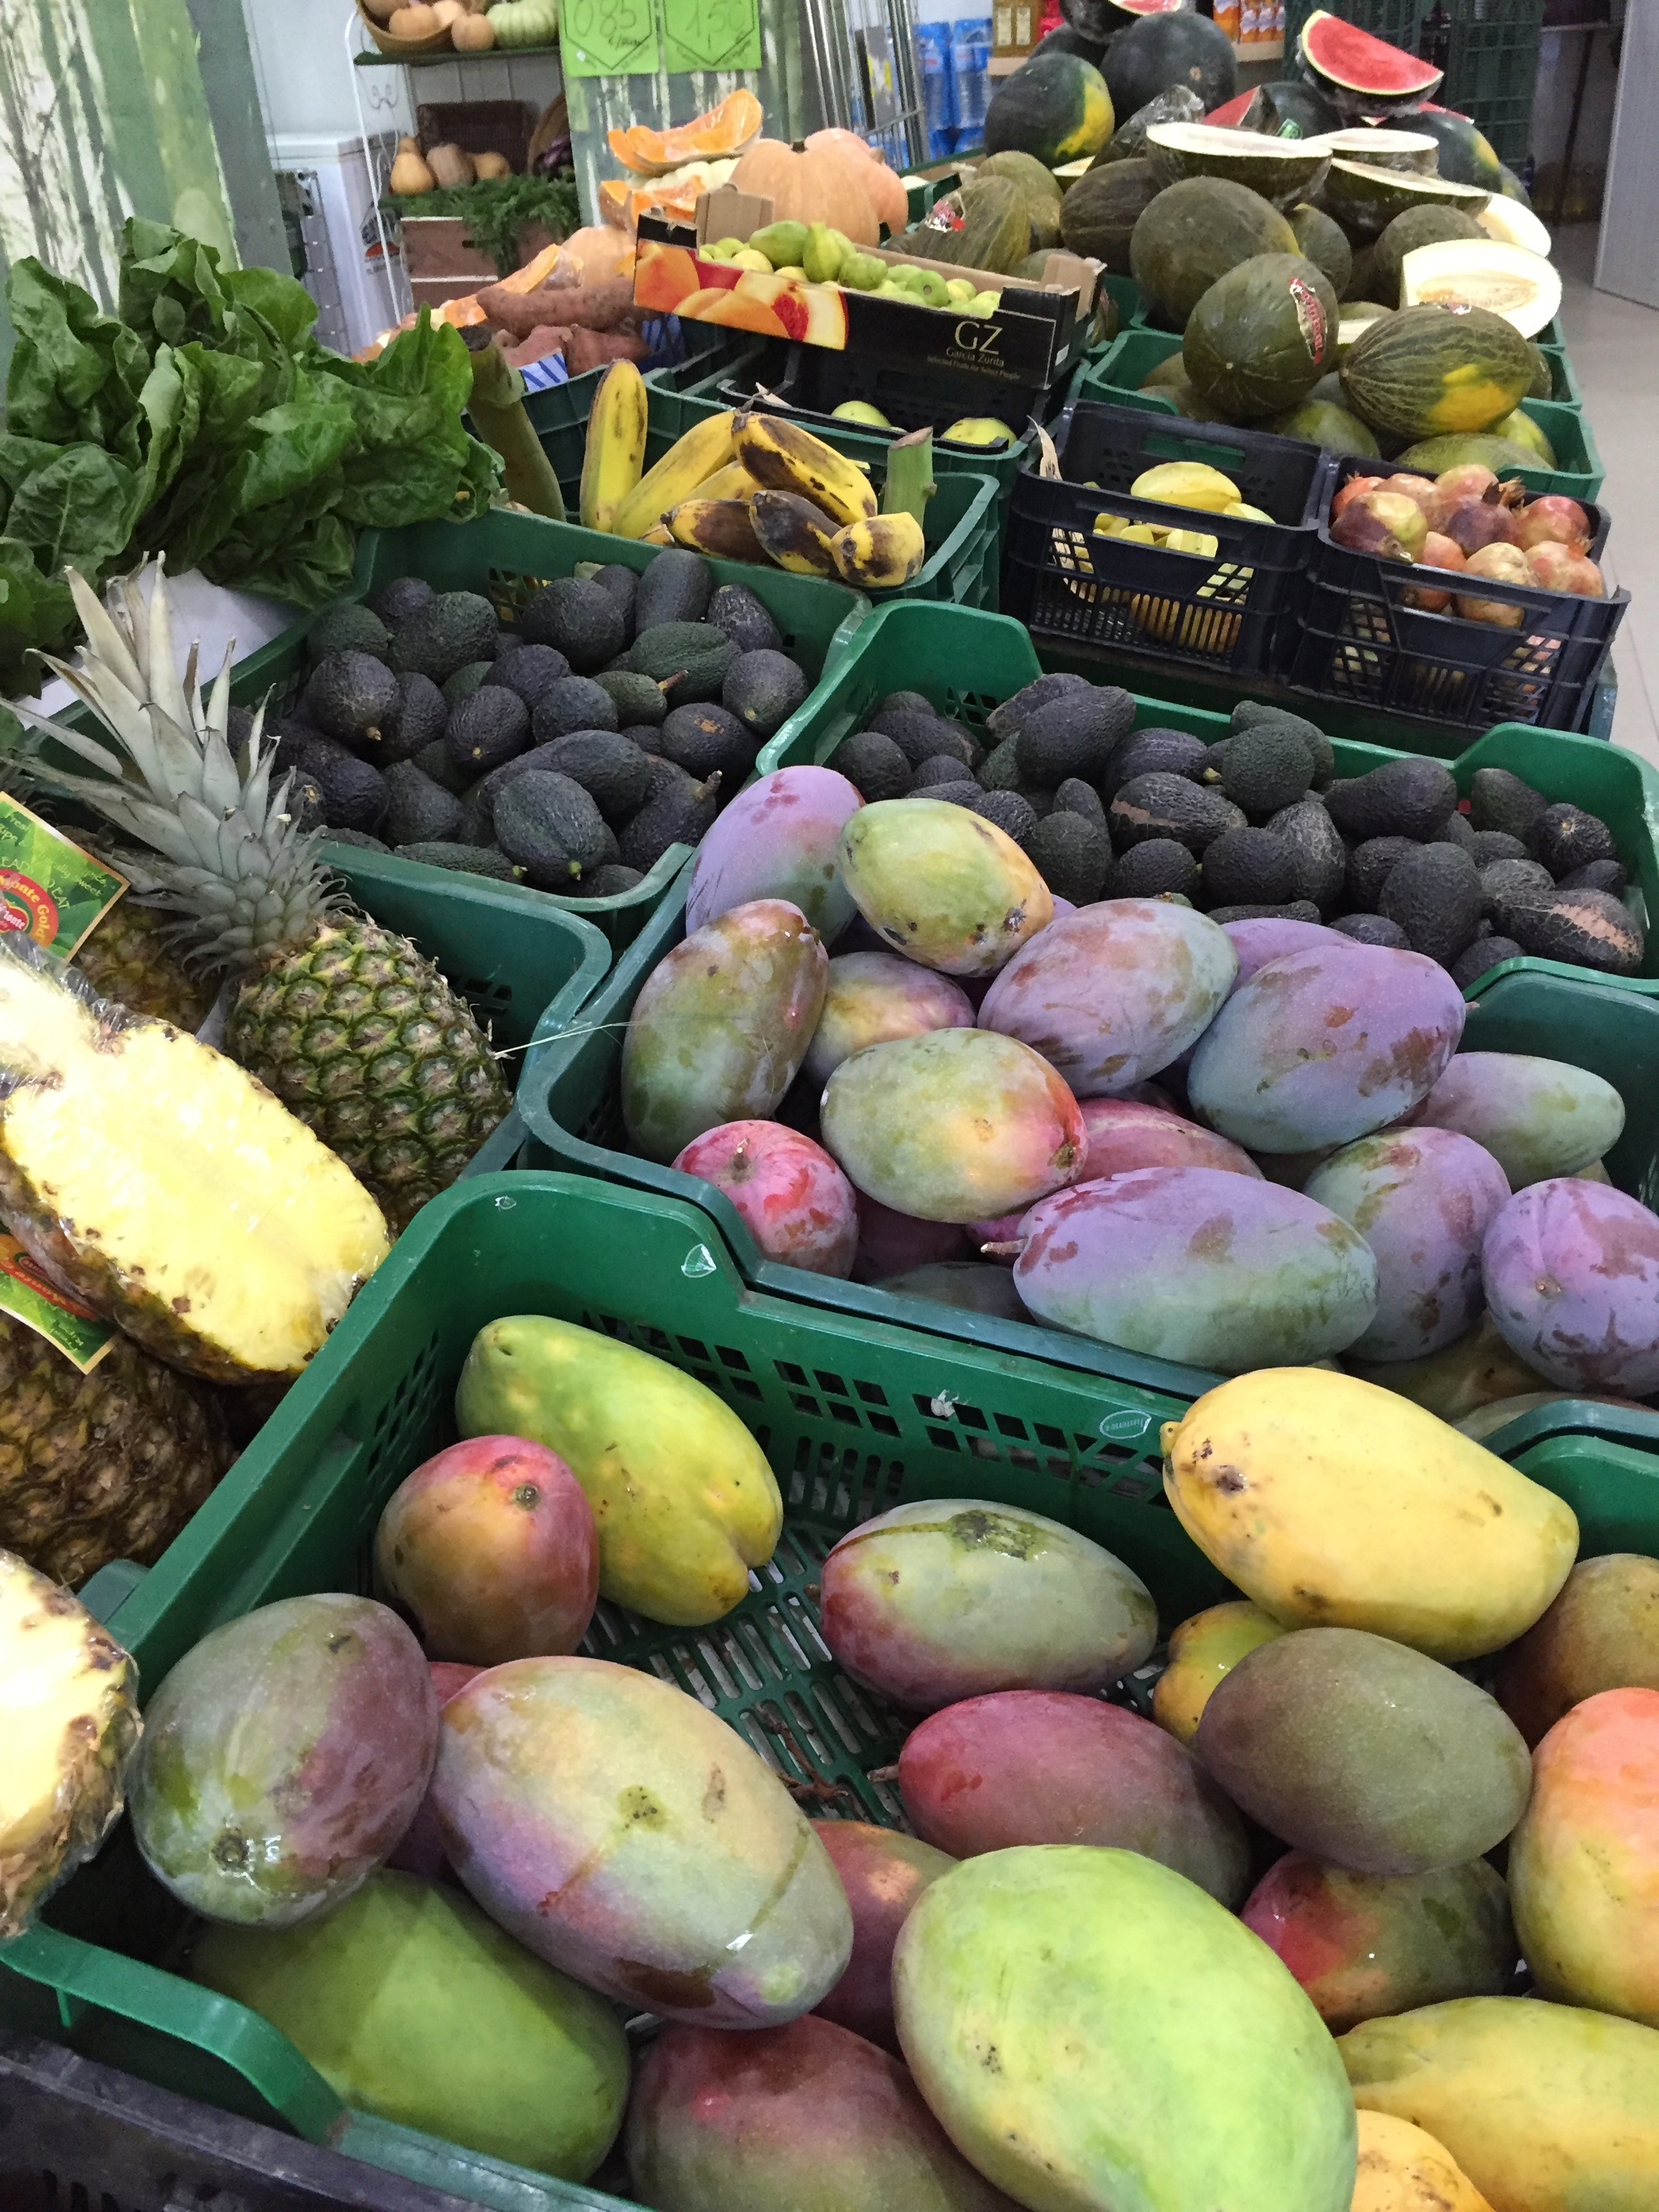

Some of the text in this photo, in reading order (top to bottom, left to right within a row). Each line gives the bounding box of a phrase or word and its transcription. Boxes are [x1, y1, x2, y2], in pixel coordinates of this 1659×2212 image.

[954, 320, 1003, 355] GZ
[978, 354, 1004, 367] Zurita
[0, 855, 35, 875] EADY
[5, 878, 50, 939] onte Gold
